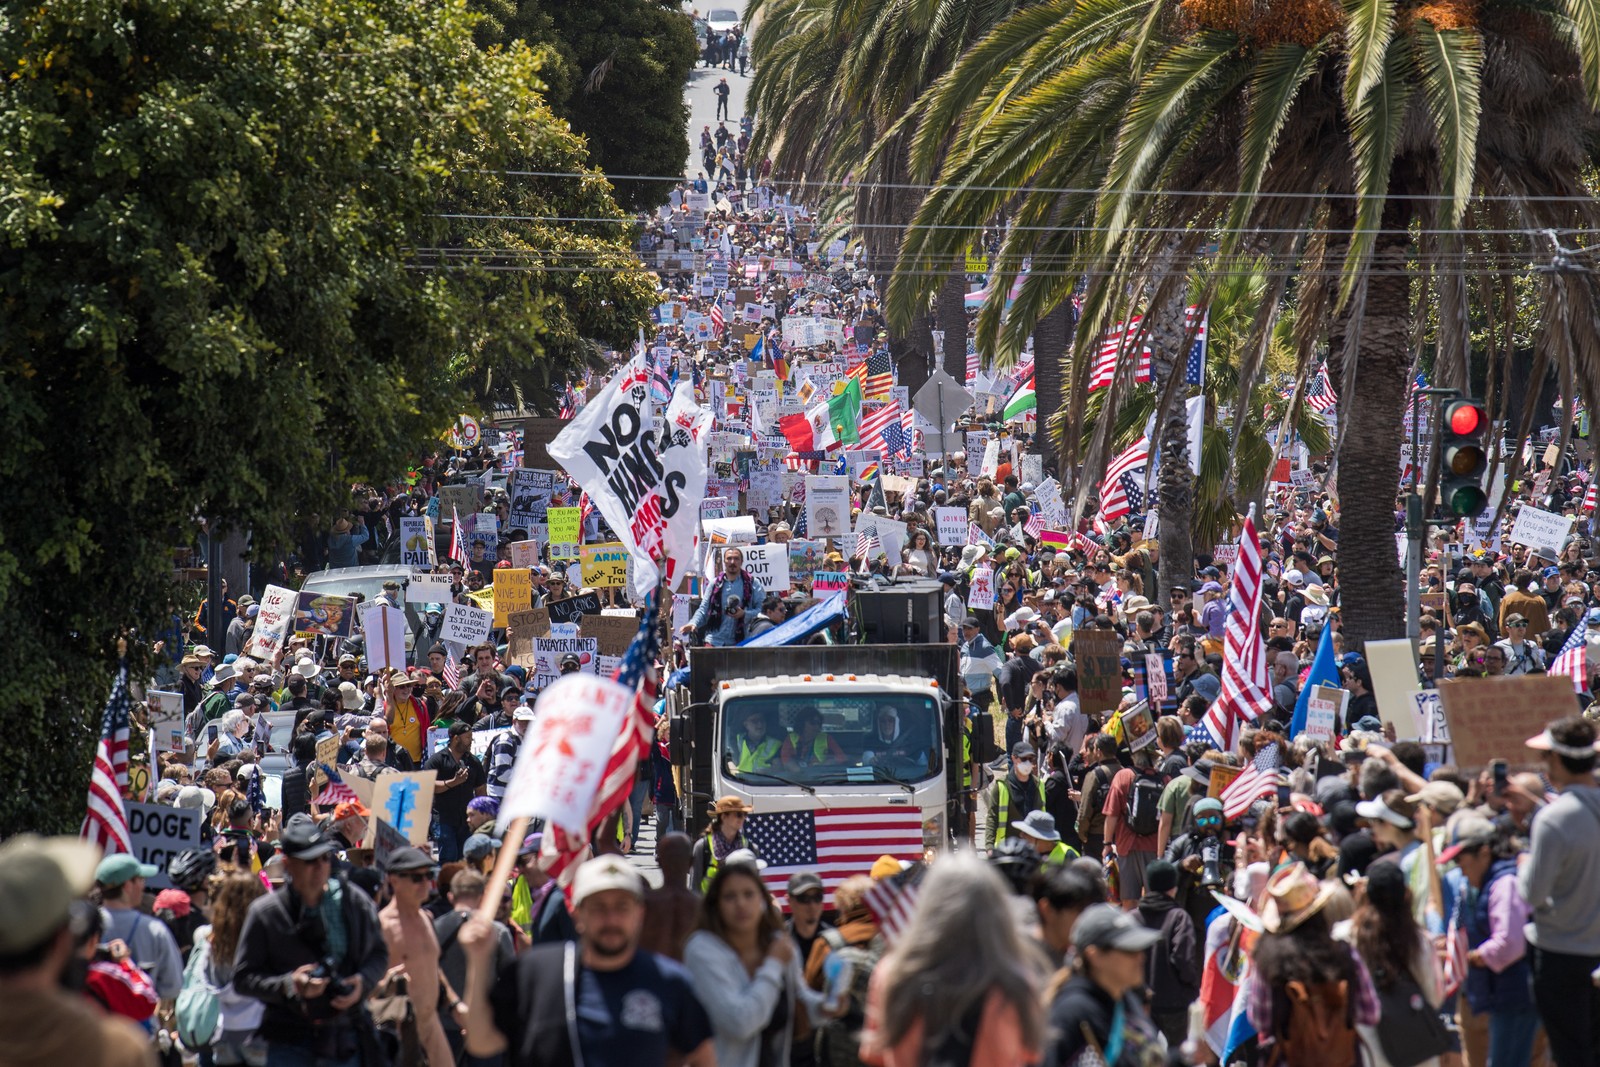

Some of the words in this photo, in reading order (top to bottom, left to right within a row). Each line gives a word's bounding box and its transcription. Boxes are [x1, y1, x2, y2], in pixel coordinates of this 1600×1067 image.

[814, 364, 842, 374] FUCK
[583, 402, 641, 478] NO
[519, 472, 532, 480] THEY
[533, 473, 551, 481] BLAME
[608, 430, 686, 519] KINGS
[516, 480, 551, 488] IMMIGRANTS
[702, 500, 725, 509] LOSER
[549, 516, 580, 524] RESISTING
[594, 553, 629, 562] ARMY
[747, 550, 766, 560] ICE
[746, 563, 769, 574] OUT
[496, 574, 506, 583] NO
[584, 570, 606, 585] fuck
[607, 576, 626, 584] Tru
[816, 574, 825, 588] IT
[827, 574, 846, 588] WAS
[497, 590, 514, 599] VIVE
[268, 596, 280, 605] ICE
[555, 604, 570, 616] NO
[573, 596, 596, 612] KINGS
[455, 608, 466, 616] NO
[470, 610, 486, 620] ONE
[459, 618, 486, 628] ILLEGAL
[512, 612, 544, 627] STOP
[454, 632, 474, 640] LAND!
[463, 627, 486, 635] STOLEN
[536, 638, 569, 652] TAXPAYER
[570, 638, 596, 651] FUNDED
[1150, 660, 1159, 668] NO
[130, 809, 192, 840] DOGE
